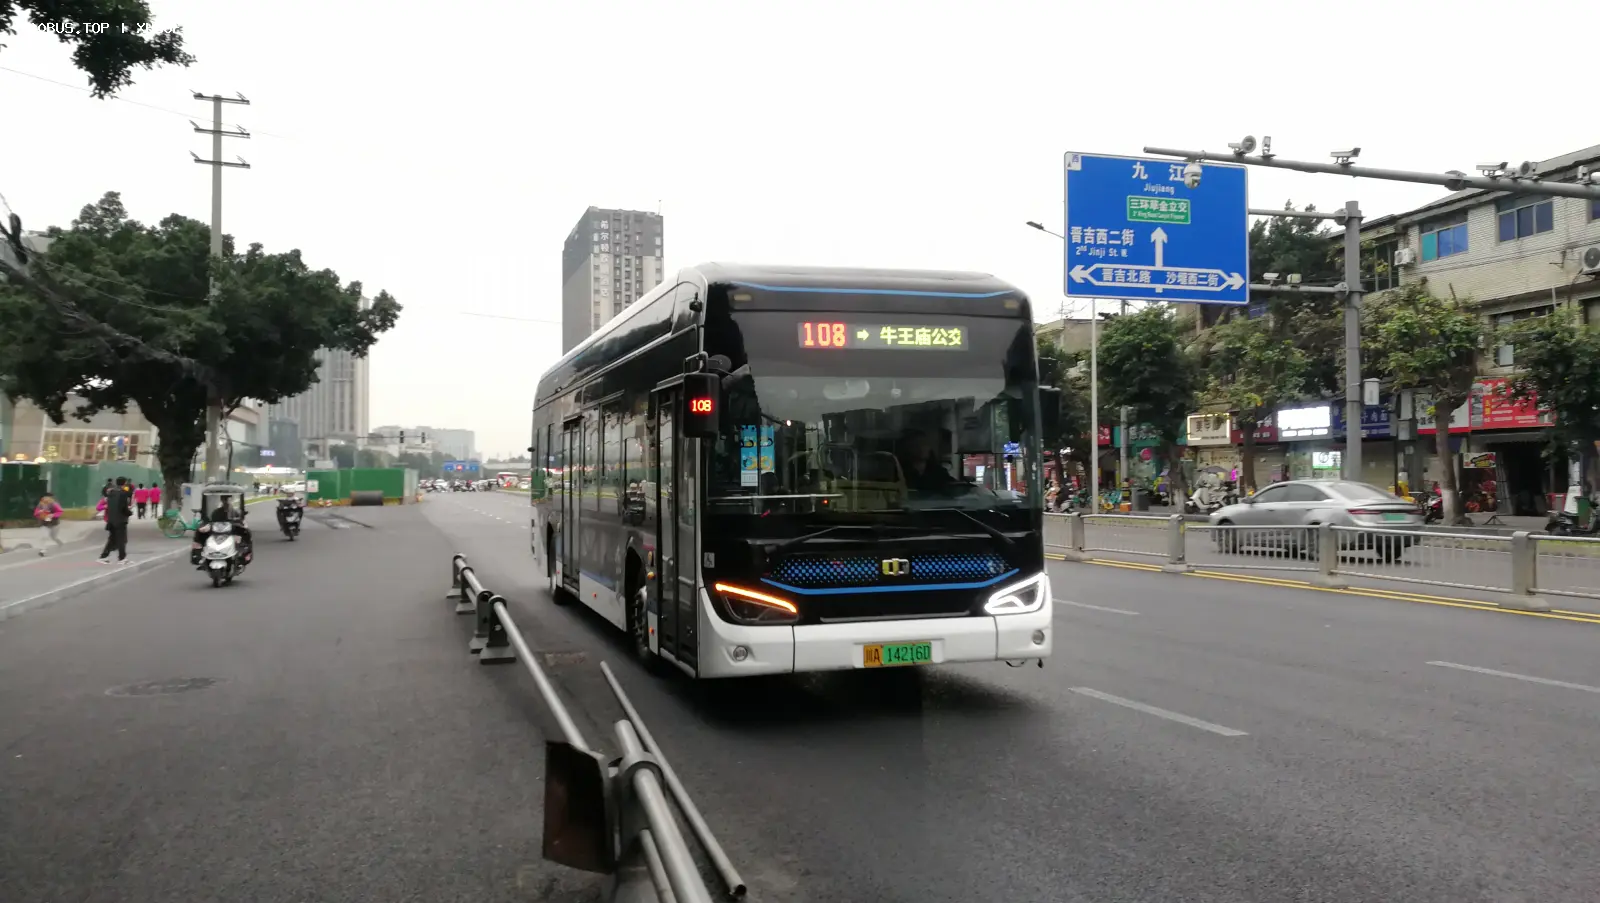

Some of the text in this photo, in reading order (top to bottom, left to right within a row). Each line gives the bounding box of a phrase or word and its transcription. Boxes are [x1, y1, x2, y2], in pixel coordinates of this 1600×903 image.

[1143, 182, 1175, 195] Jiujiang
[1070, 226, 1135, 246] 晋吉西二街
[1101, 268, 1151, 284] 晋吉北路
[803, 322, 962, 347] 108 牛王庙公交
[692, 399, 712, 412] 108
[887, 645, 930, 663] 14216D
